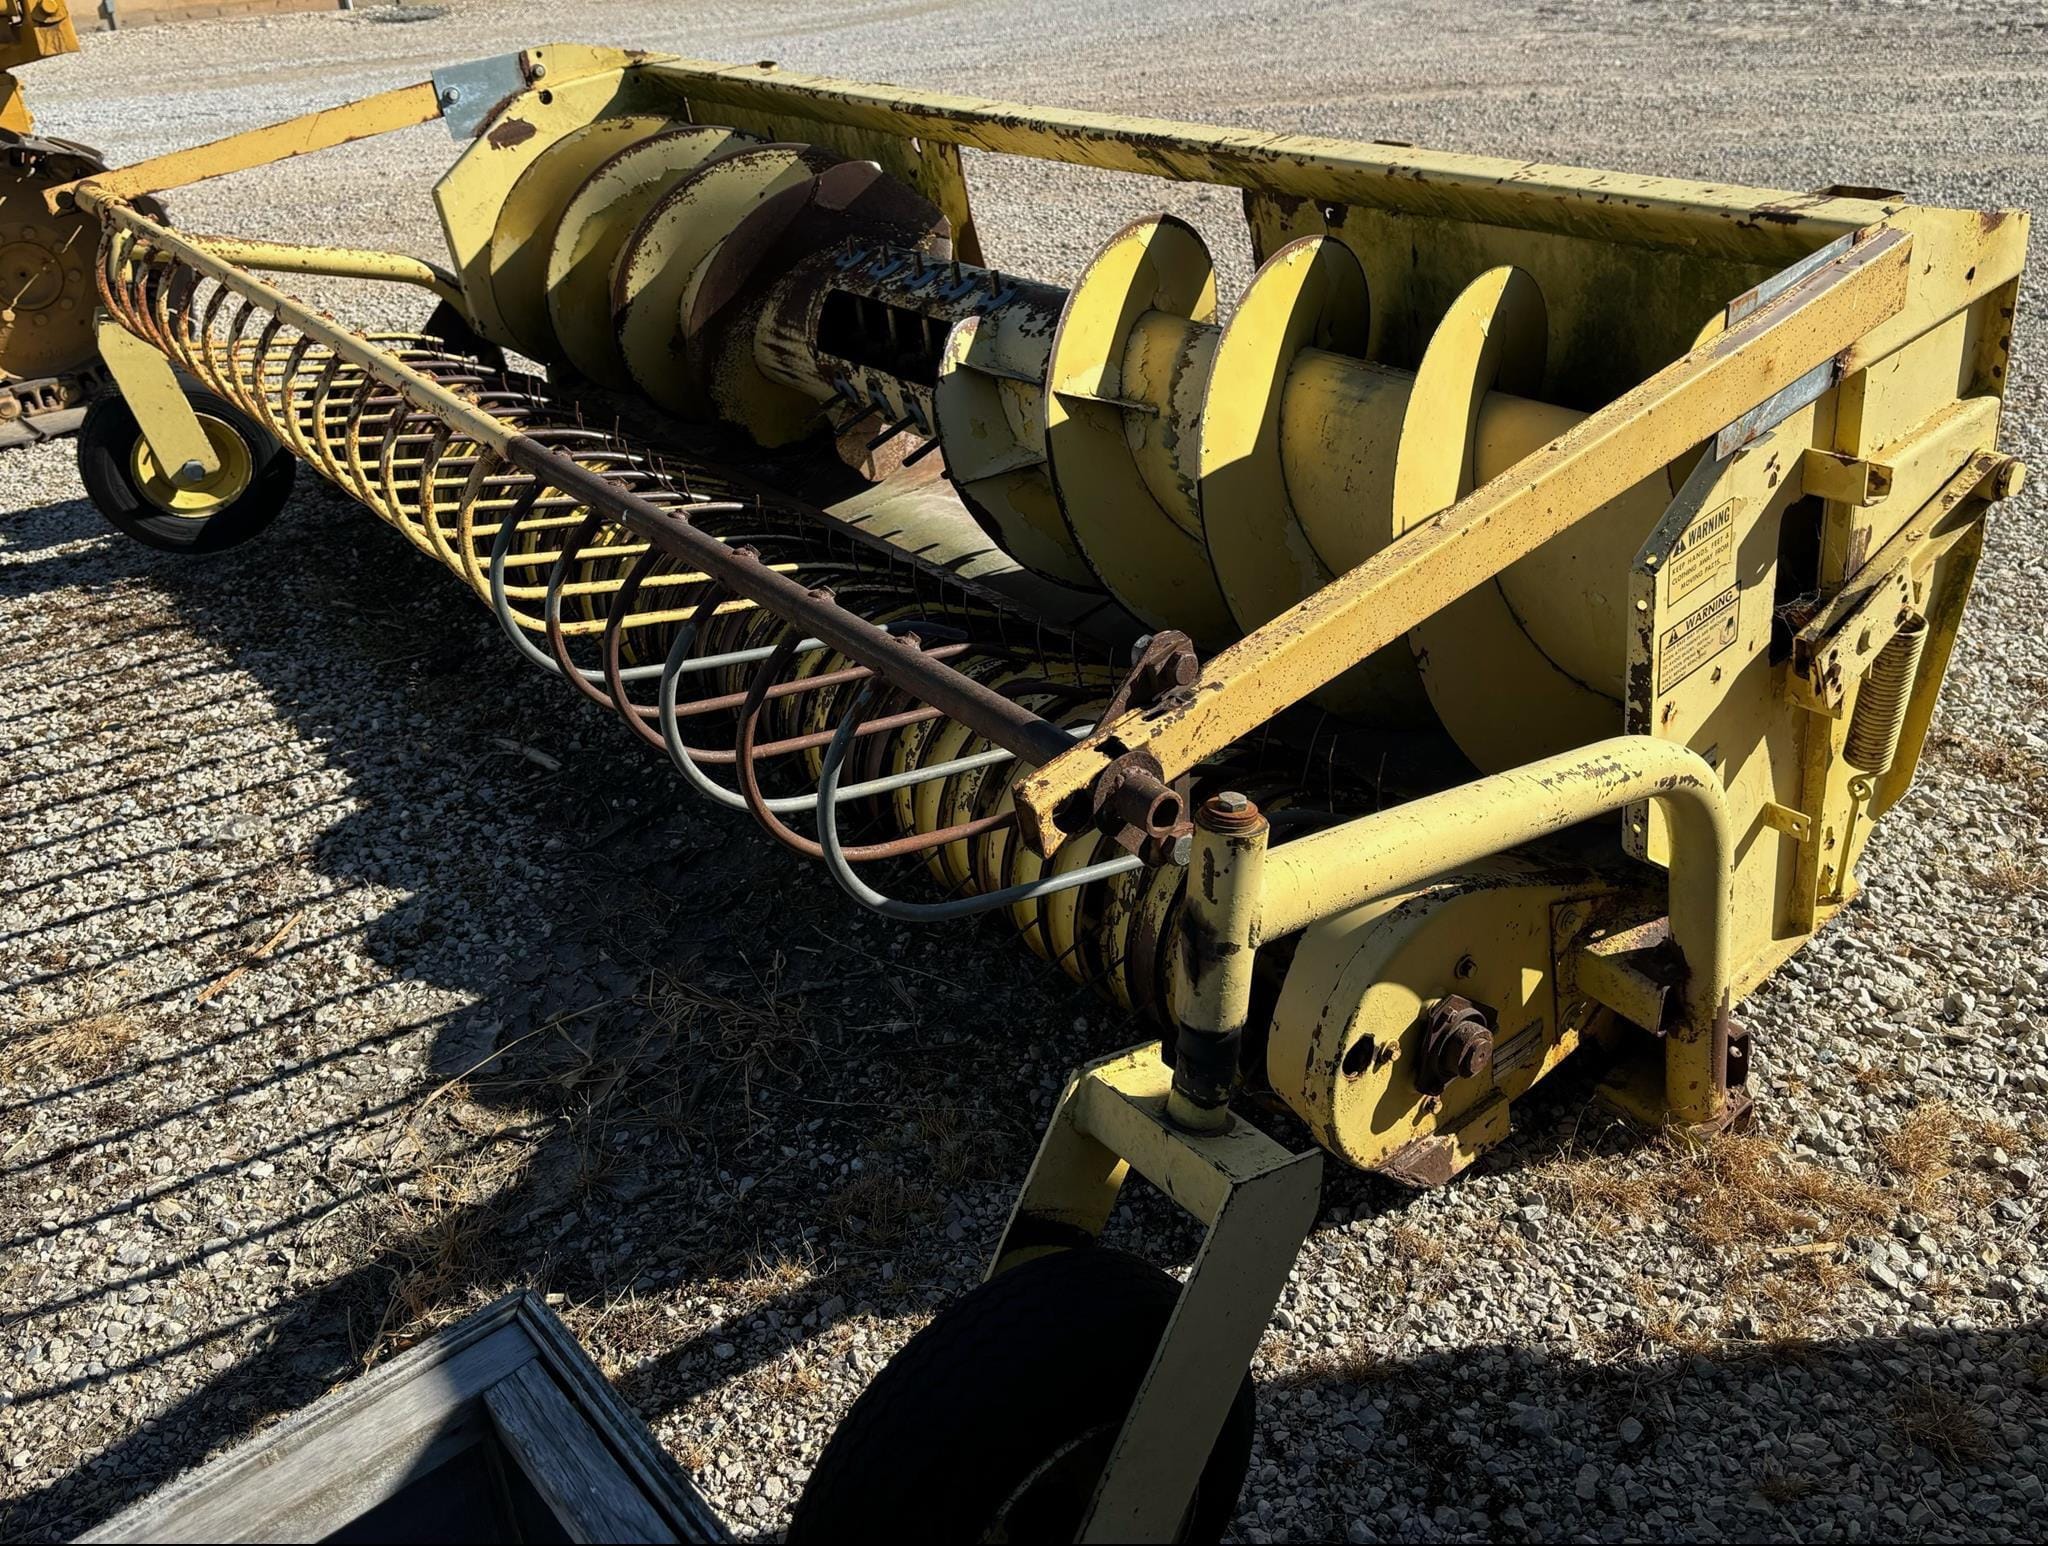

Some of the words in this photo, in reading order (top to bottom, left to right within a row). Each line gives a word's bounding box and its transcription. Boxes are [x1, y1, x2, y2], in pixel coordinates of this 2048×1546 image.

[1688, 506, 1730, 547] WARNING
[1671, 561, 1686, 576] KEEP
[1711, 535, 1723, 549] FEET
[1671, 564, 1697, 586] CLOTHING
[1699, 552, 1713, 567] AWAY
[1715, 542, 1729, 557] FROM
[1680, 570, 1703, 590] MOVING
[1685, 590, 1733, 631] WARNING
